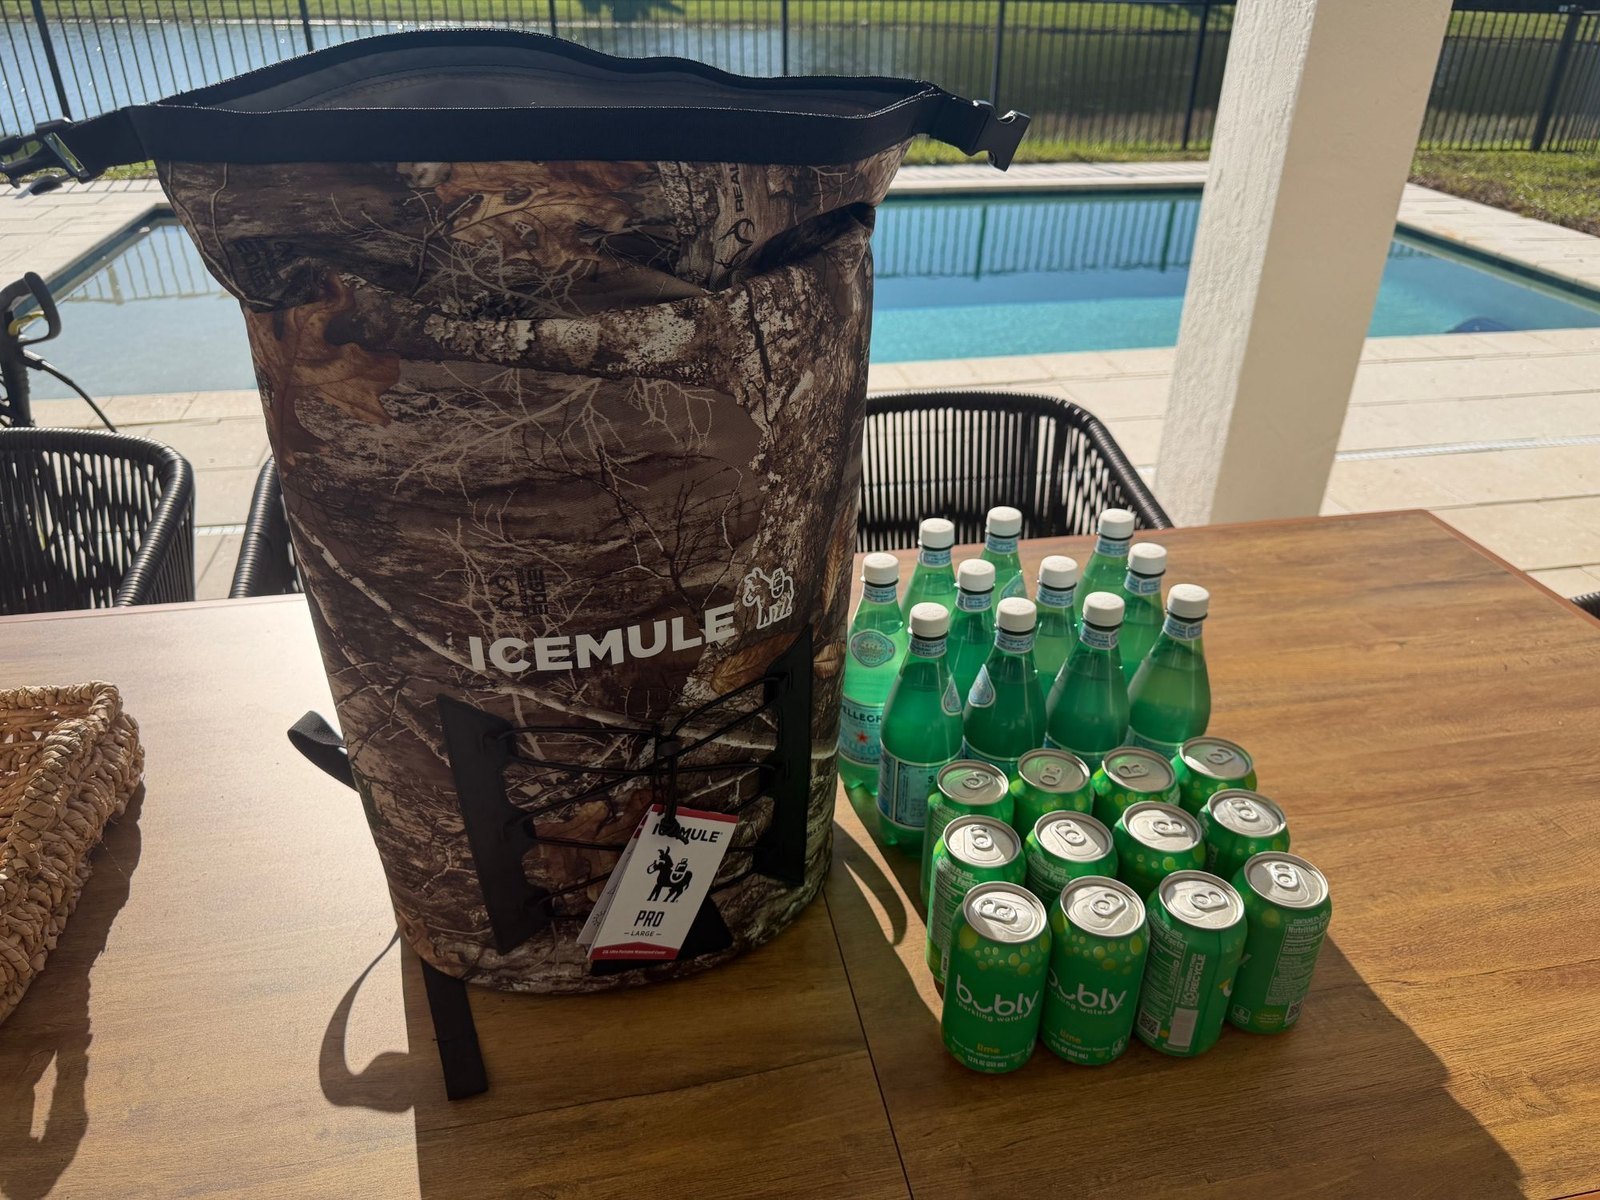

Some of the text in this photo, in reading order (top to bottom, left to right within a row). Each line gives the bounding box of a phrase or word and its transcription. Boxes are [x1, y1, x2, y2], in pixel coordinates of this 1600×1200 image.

[468, 602, 736, 673] ICEMULE
[651, 823, 720, 843] IMULE
[633, 910, 665, 927] PRO
[1190, 954, 1206, 993] RECYCLE
[956, 974, 1040, 1018] bubly
[977, 1043, 1000, 1054] lime
